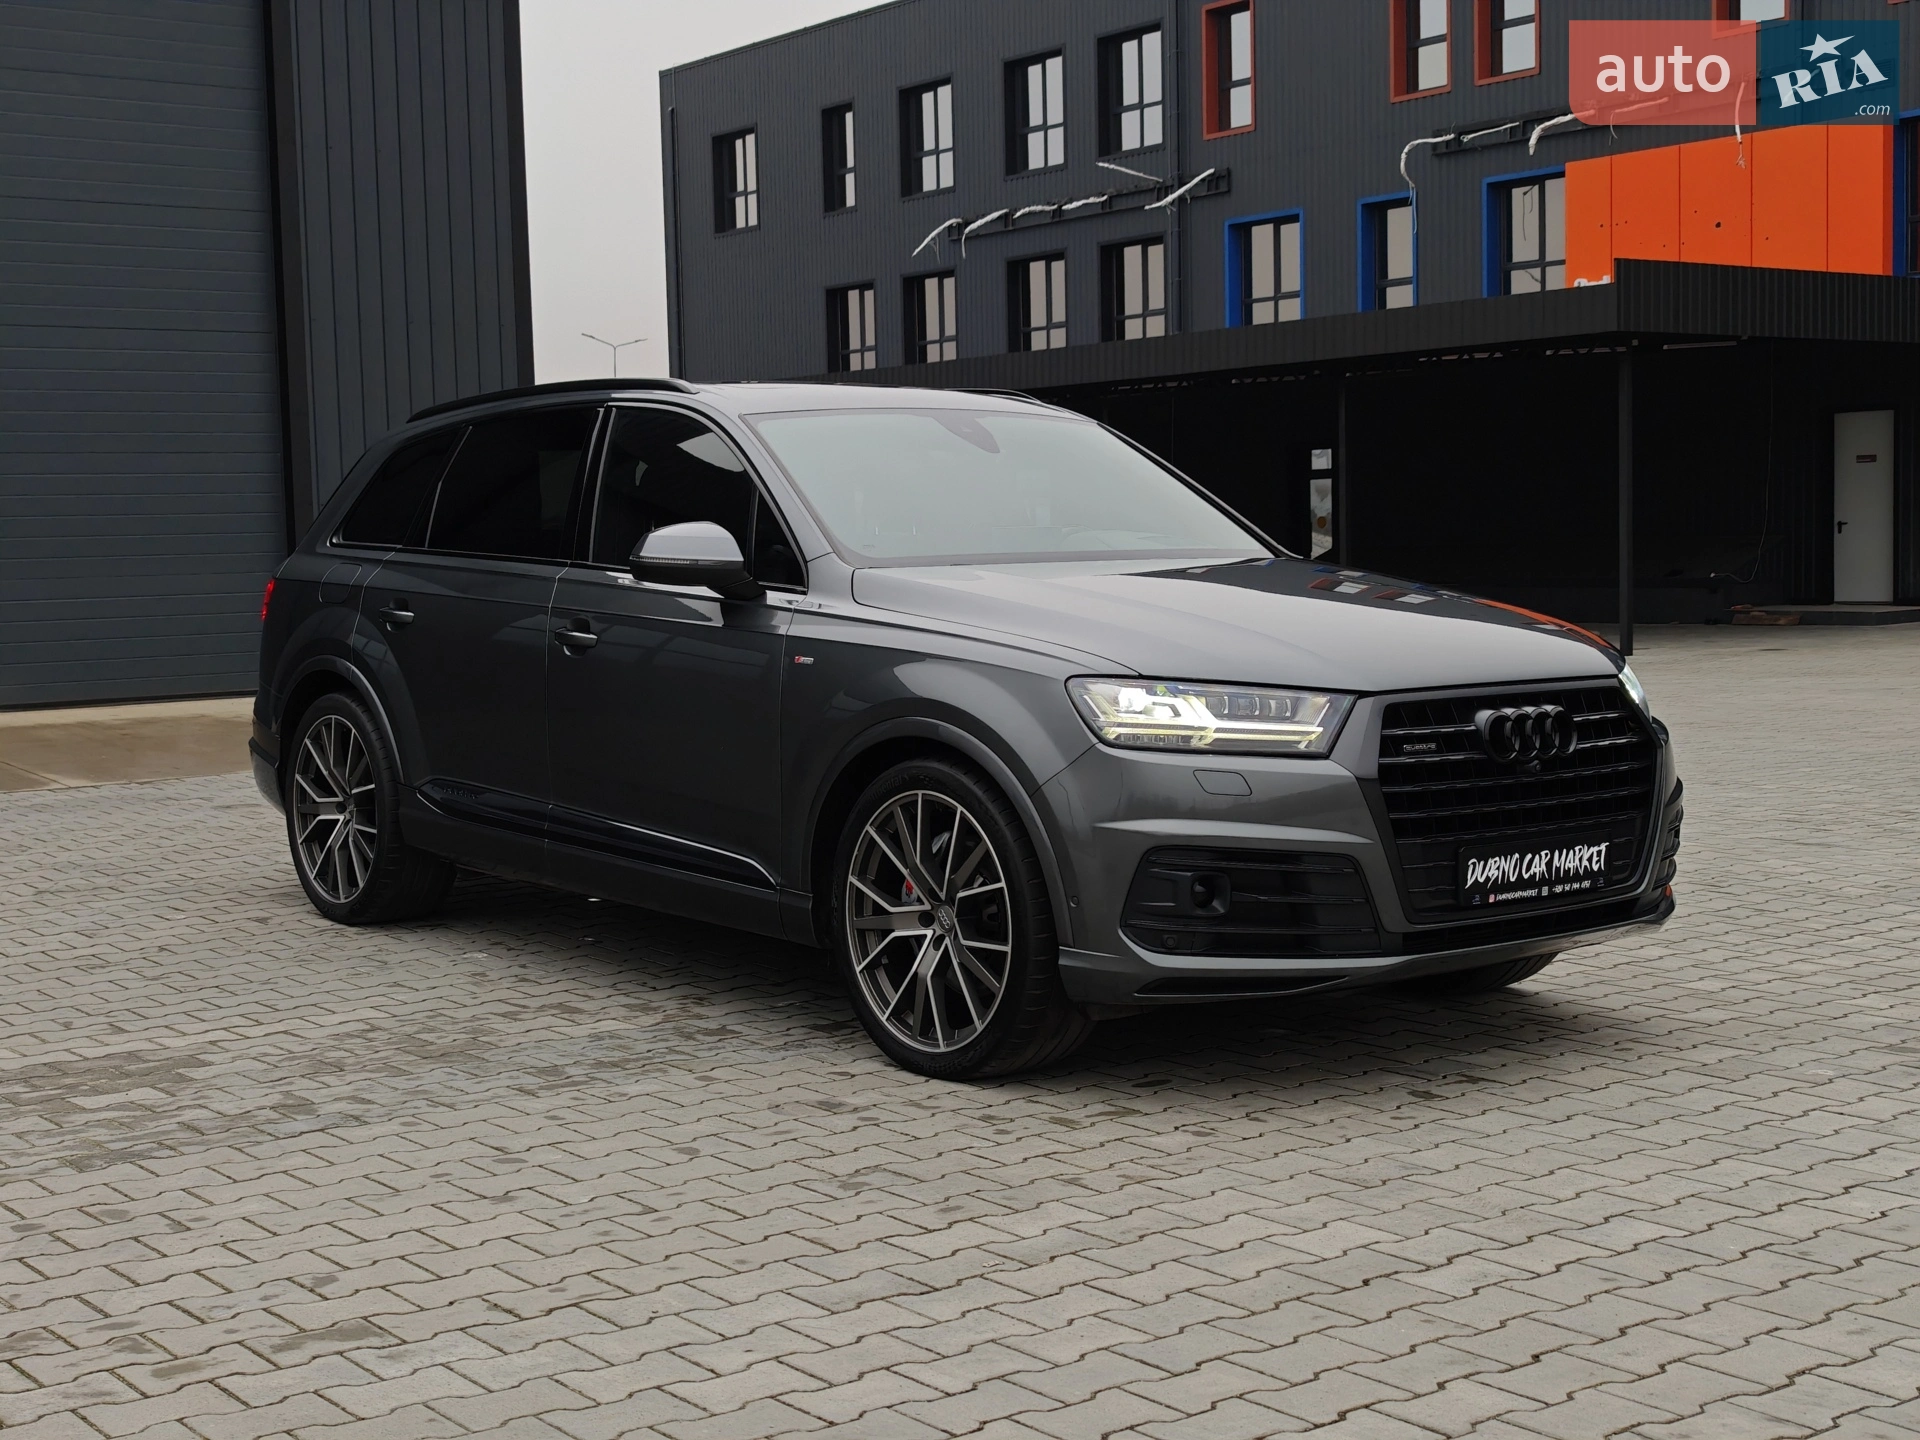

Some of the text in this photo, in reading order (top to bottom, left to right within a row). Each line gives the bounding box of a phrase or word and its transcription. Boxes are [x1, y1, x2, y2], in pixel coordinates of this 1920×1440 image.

[1465, 842, 1610, 889] DUBNO CAR MARKET
